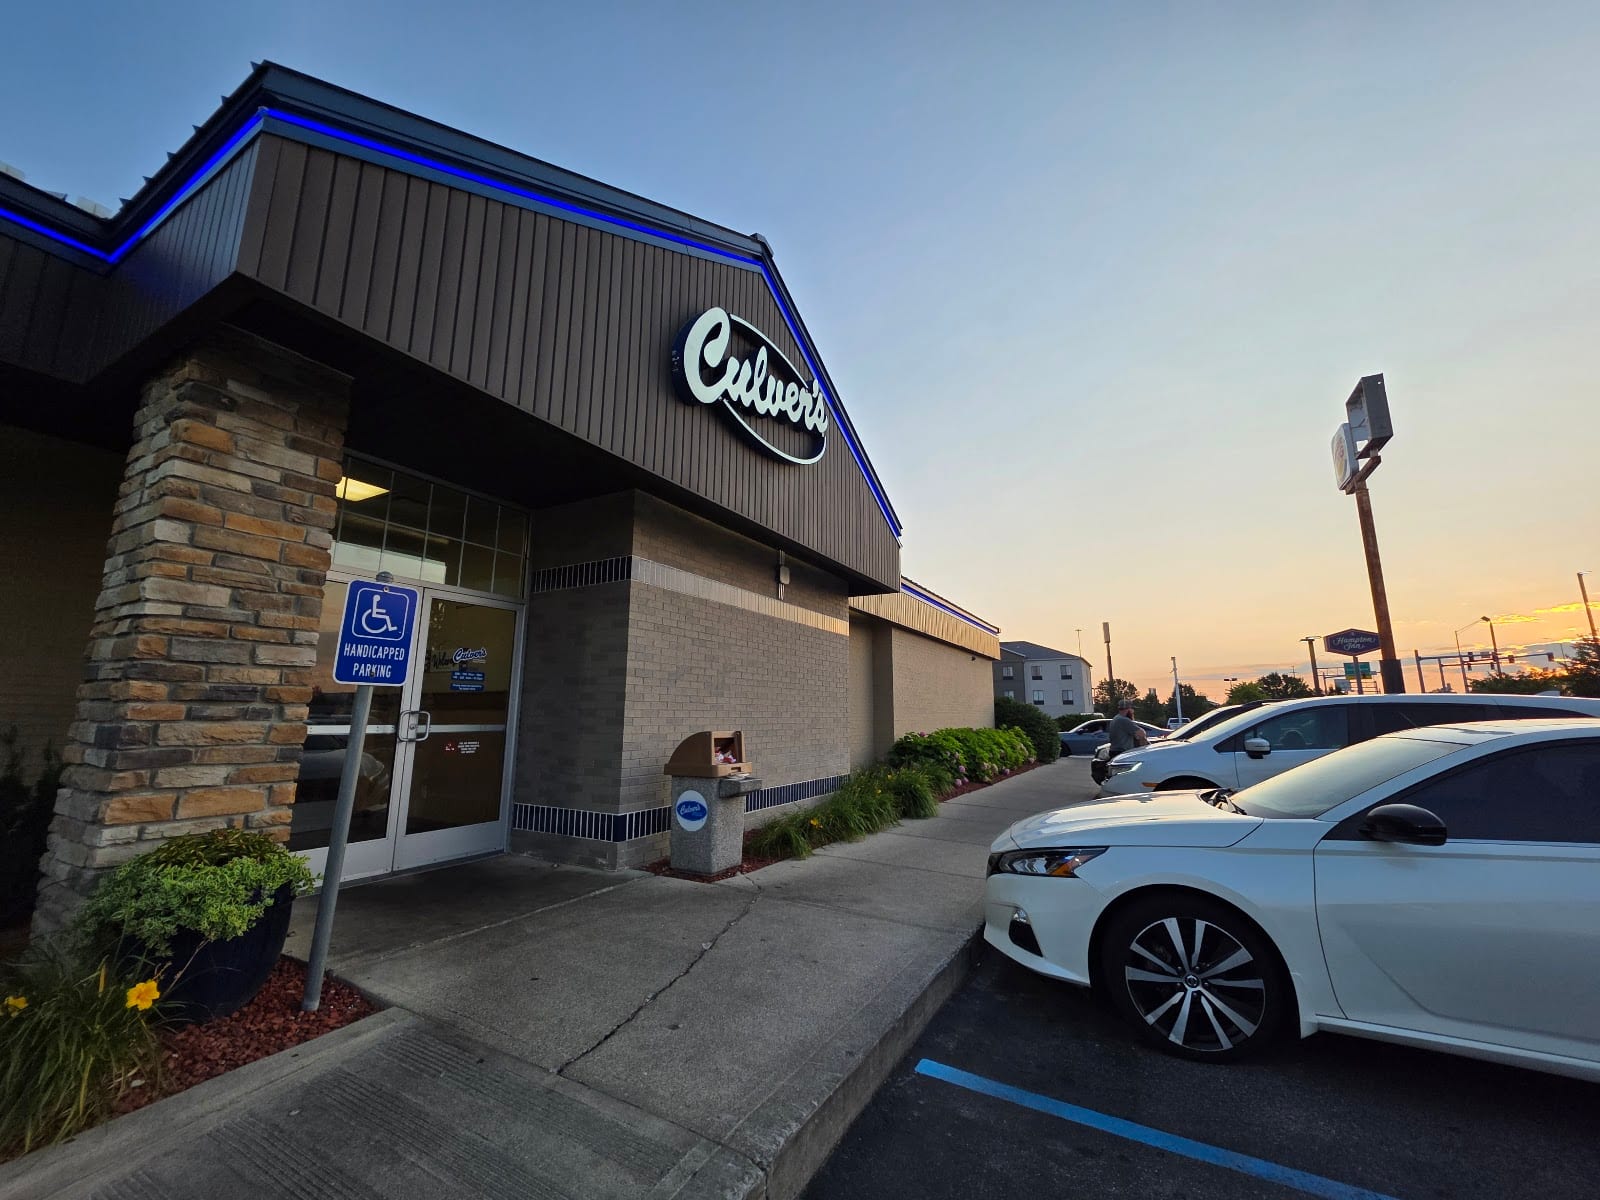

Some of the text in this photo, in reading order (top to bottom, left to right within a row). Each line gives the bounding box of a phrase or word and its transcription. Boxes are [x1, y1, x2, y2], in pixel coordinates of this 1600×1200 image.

[684, 307, 828, 434] Culver's
[1333, 636, 1376, 645] Hampton
[1344, 643, 1364, 651] Inn
[343, 643, 405, 661] HANDICAPPED
[453, 647, 487, 663] Culver's
[352, 662, 392, 678] PARKING
